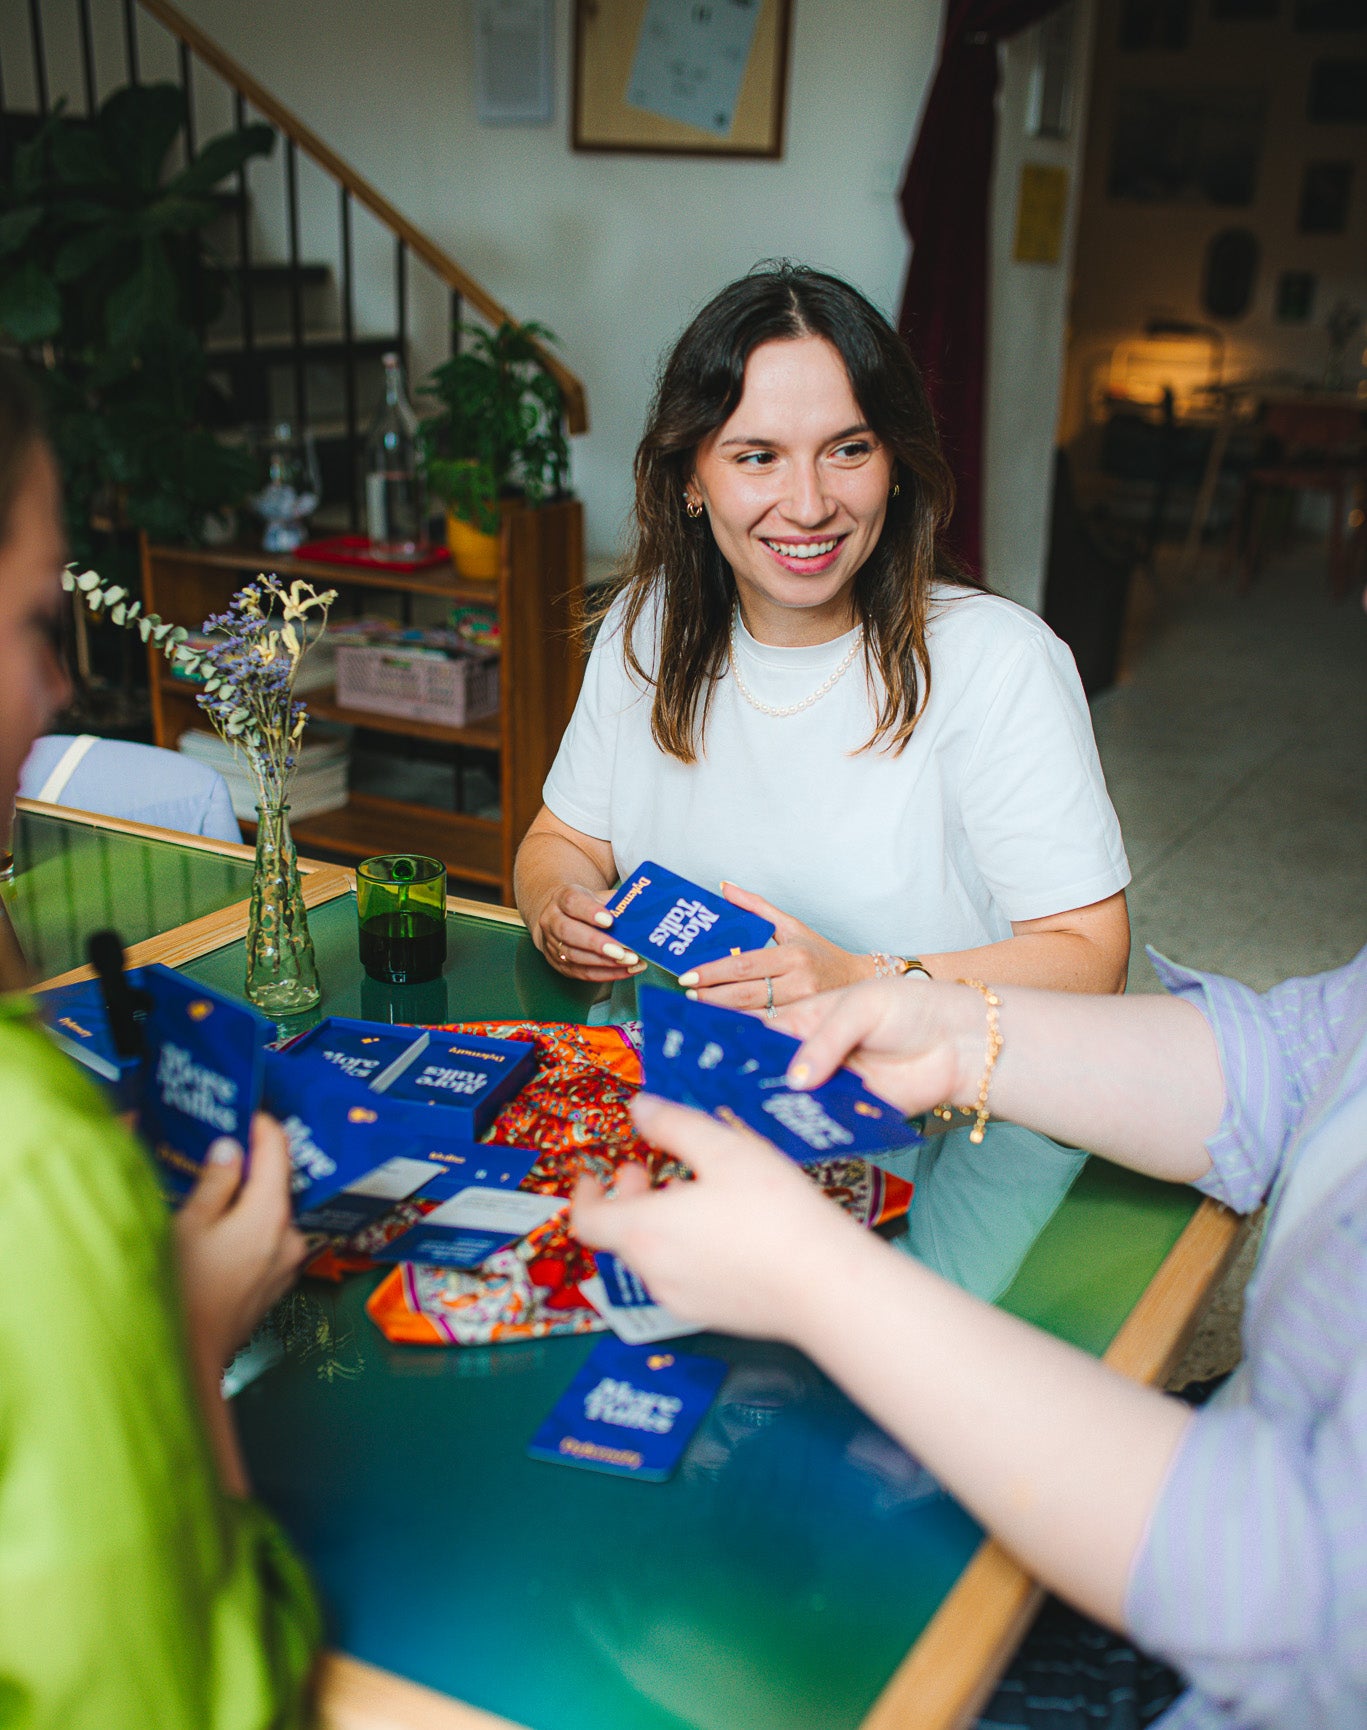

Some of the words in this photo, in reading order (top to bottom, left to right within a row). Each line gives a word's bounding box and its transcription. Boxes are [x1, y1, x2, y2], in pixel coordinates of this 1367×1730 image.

[610, 876, 651, 918] Dylematy
[649, 897, 702, 947] Talks
[668, 904, 720, 956] More
[415, 1075, 488, 1095] More
[422, 1065, 488, 1084] Talks
